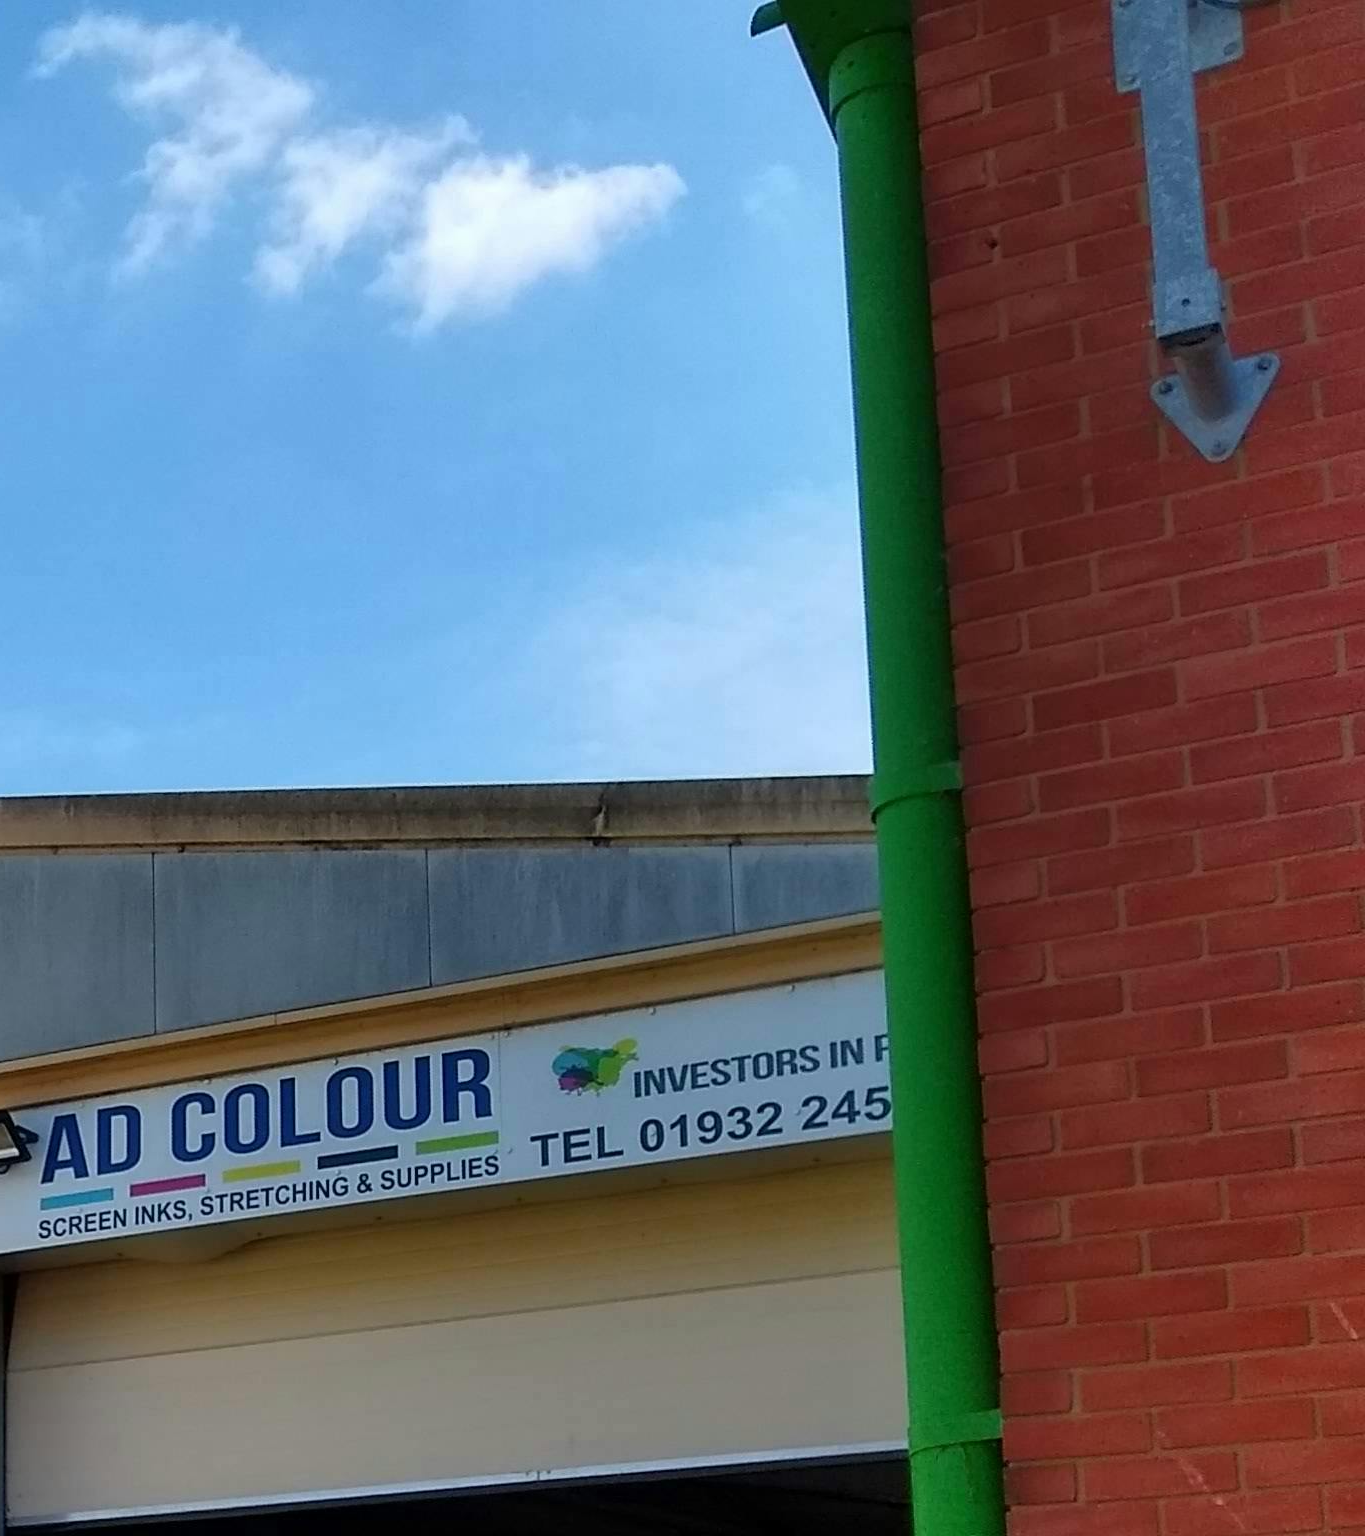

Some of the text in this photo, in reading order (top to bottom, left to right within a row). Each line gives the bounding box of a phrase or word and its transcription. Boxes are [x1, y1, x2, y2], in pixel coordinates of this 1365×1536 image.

[633, 1044, 820, 1099] INVESTORS
[829, 1036, 864, 1069] IN
[40, 1047, 494, 1184] AD COLOUR
[529, 1085, 892, 1168] TEL 01932 245
[37, 1154, 501, 1240] SCREEN INKS, STRETCHING & SUPPLIES
